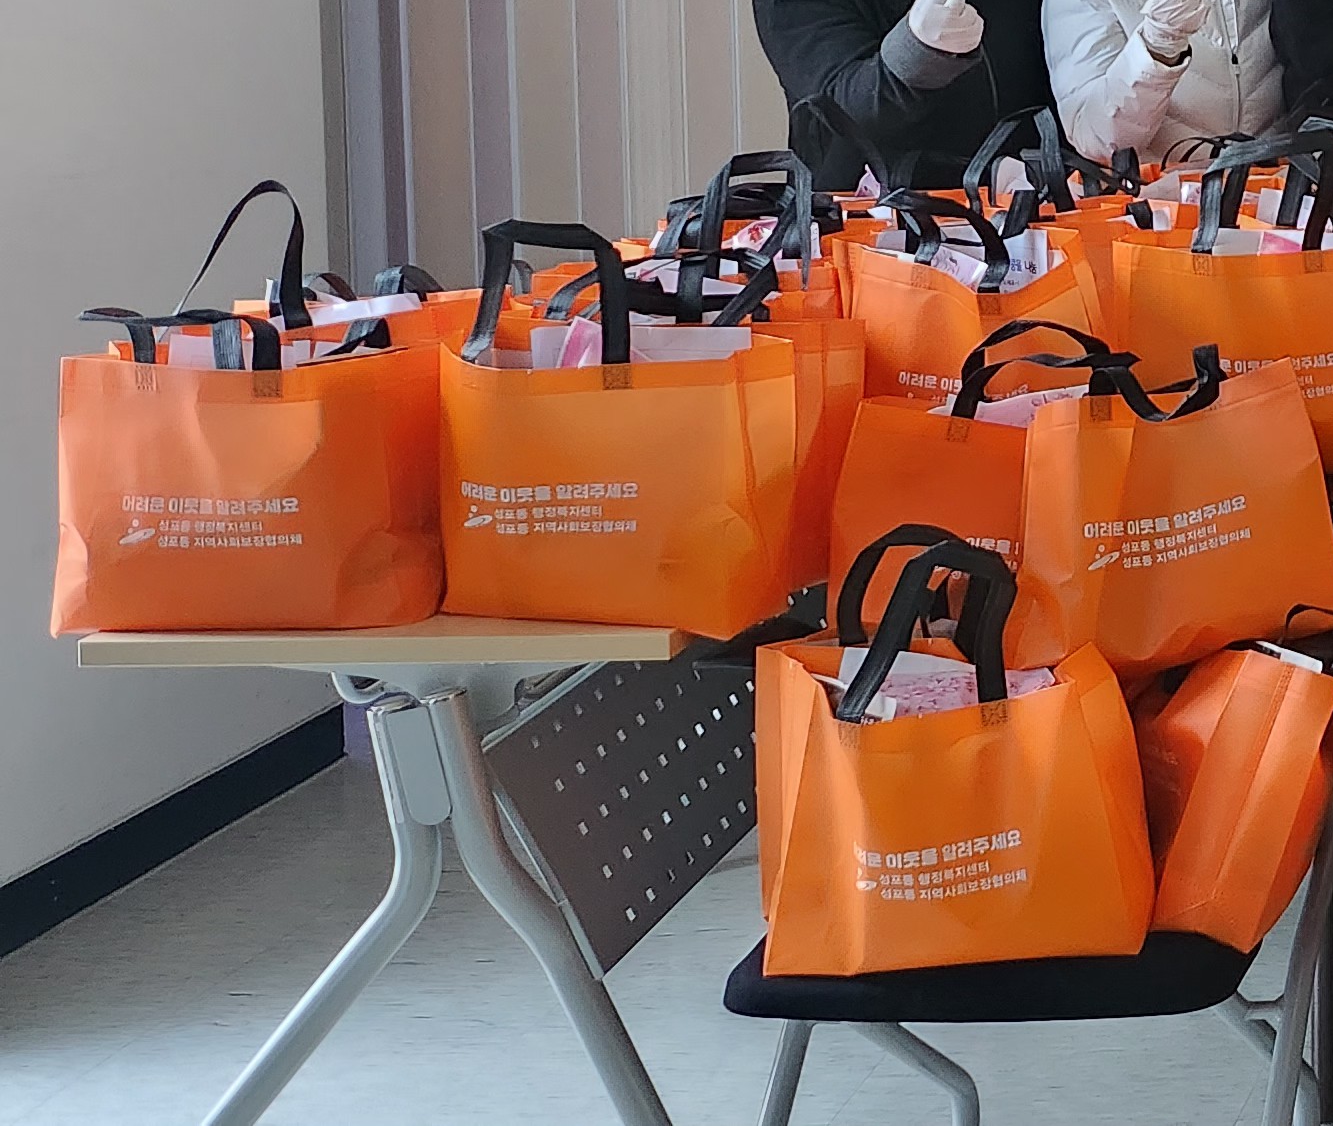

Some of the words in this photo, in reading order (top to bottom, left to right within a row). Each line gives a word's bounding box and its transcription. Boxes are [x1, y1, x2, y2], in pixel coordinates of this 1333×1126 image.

[899, 372, 936, 389] 어려운
[462, 481, 497, 501] 어려운
[500, 486, 551, 503] 이웃을
[556, 482, 638, 499] 알려주세요
[122, 495, 164, 513] 어려운
[169, 497, 213, 514] 이웃을
[217, 497, 299, 515] 알려주세요
[1084, 522, 1124, 538] 어려운
[1128, 517, 1170, 534] 이웃을
[1173, 496, 1246, 528] 알려주세요
[886, 847, 938, 869] 이웃을
[942, 830, 1022, 861] 알려주세요
